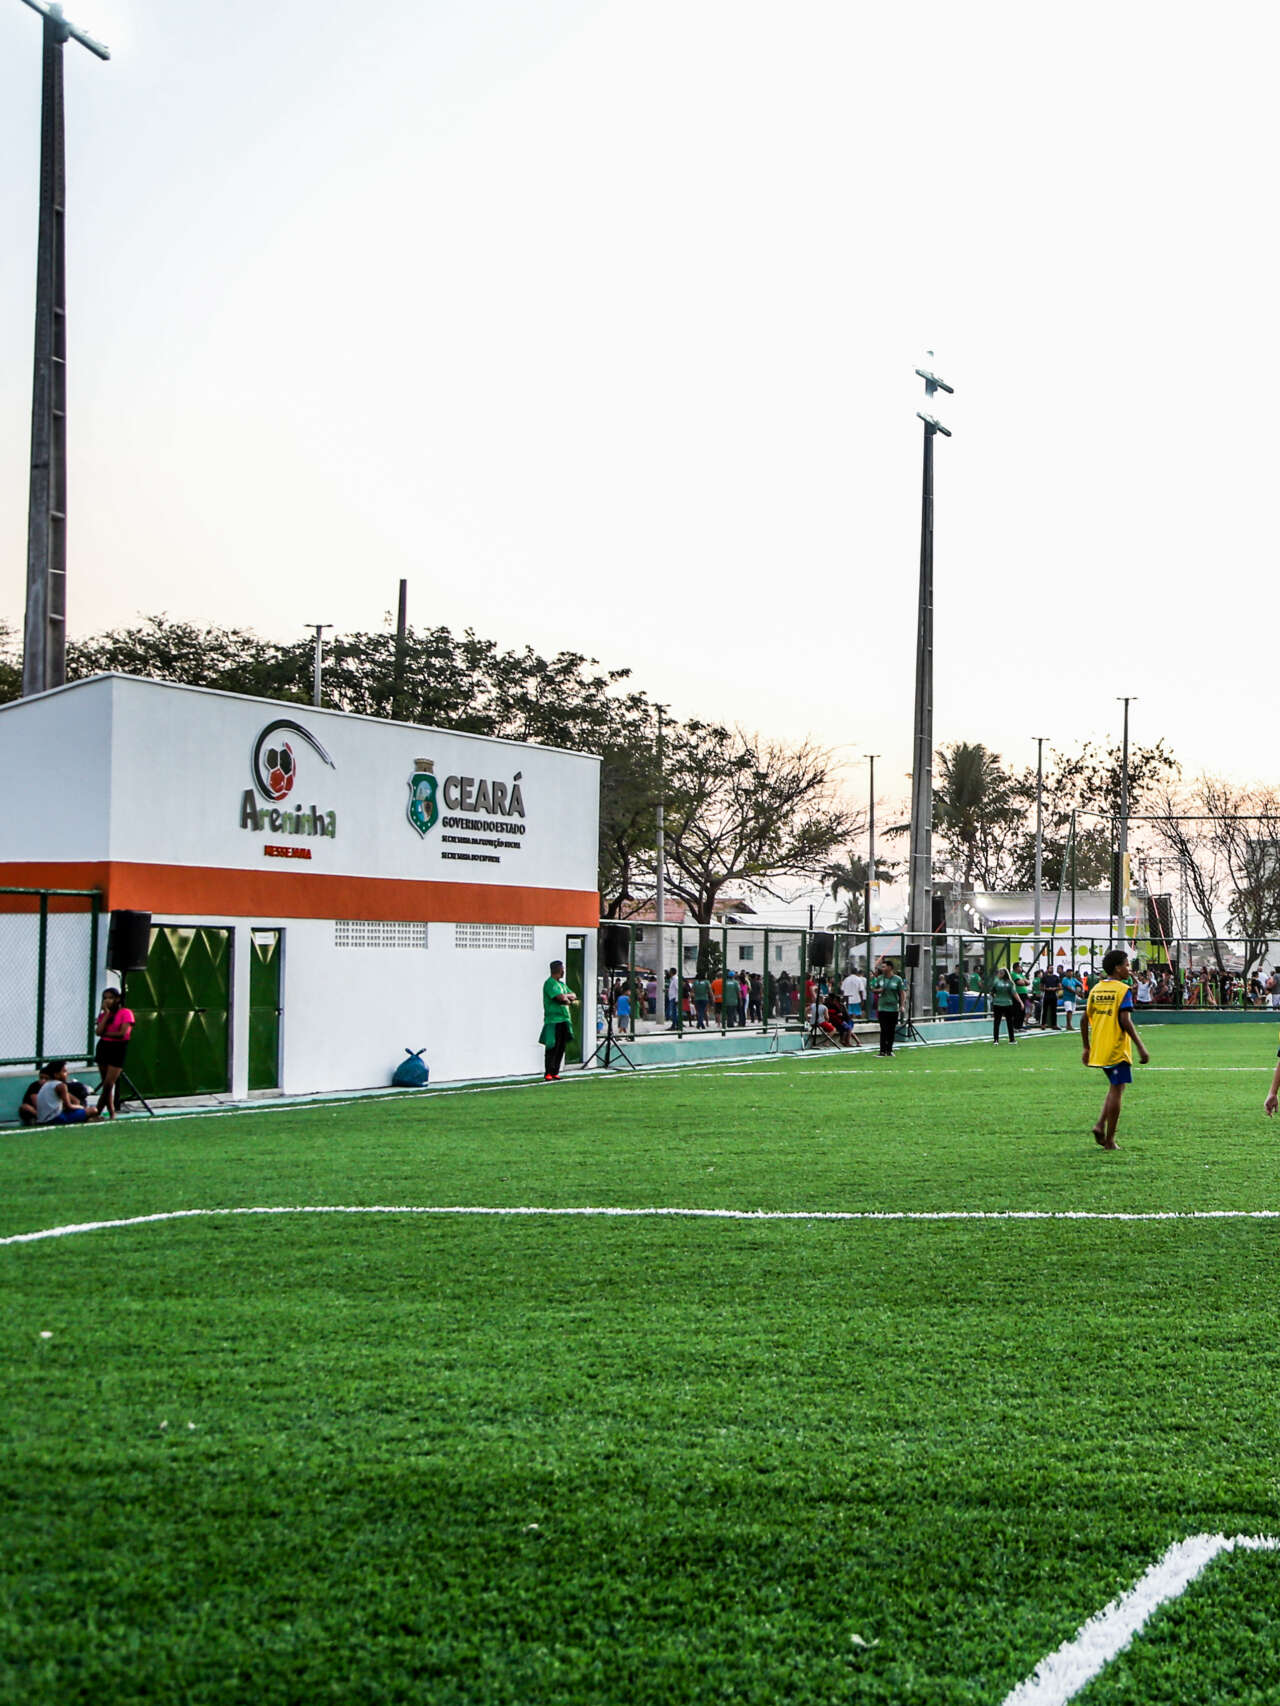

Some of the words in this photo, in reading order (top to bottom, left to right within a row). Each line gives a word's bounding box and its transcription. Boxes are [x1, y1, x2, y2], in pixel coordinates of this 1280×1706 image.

[240, 789, 336, 839] Areninha
[443, 771, 525, 818] CEARÁ
[442, 816, 482, 831] GOVERNO
[495, 821, 526, 835] ESTADO
